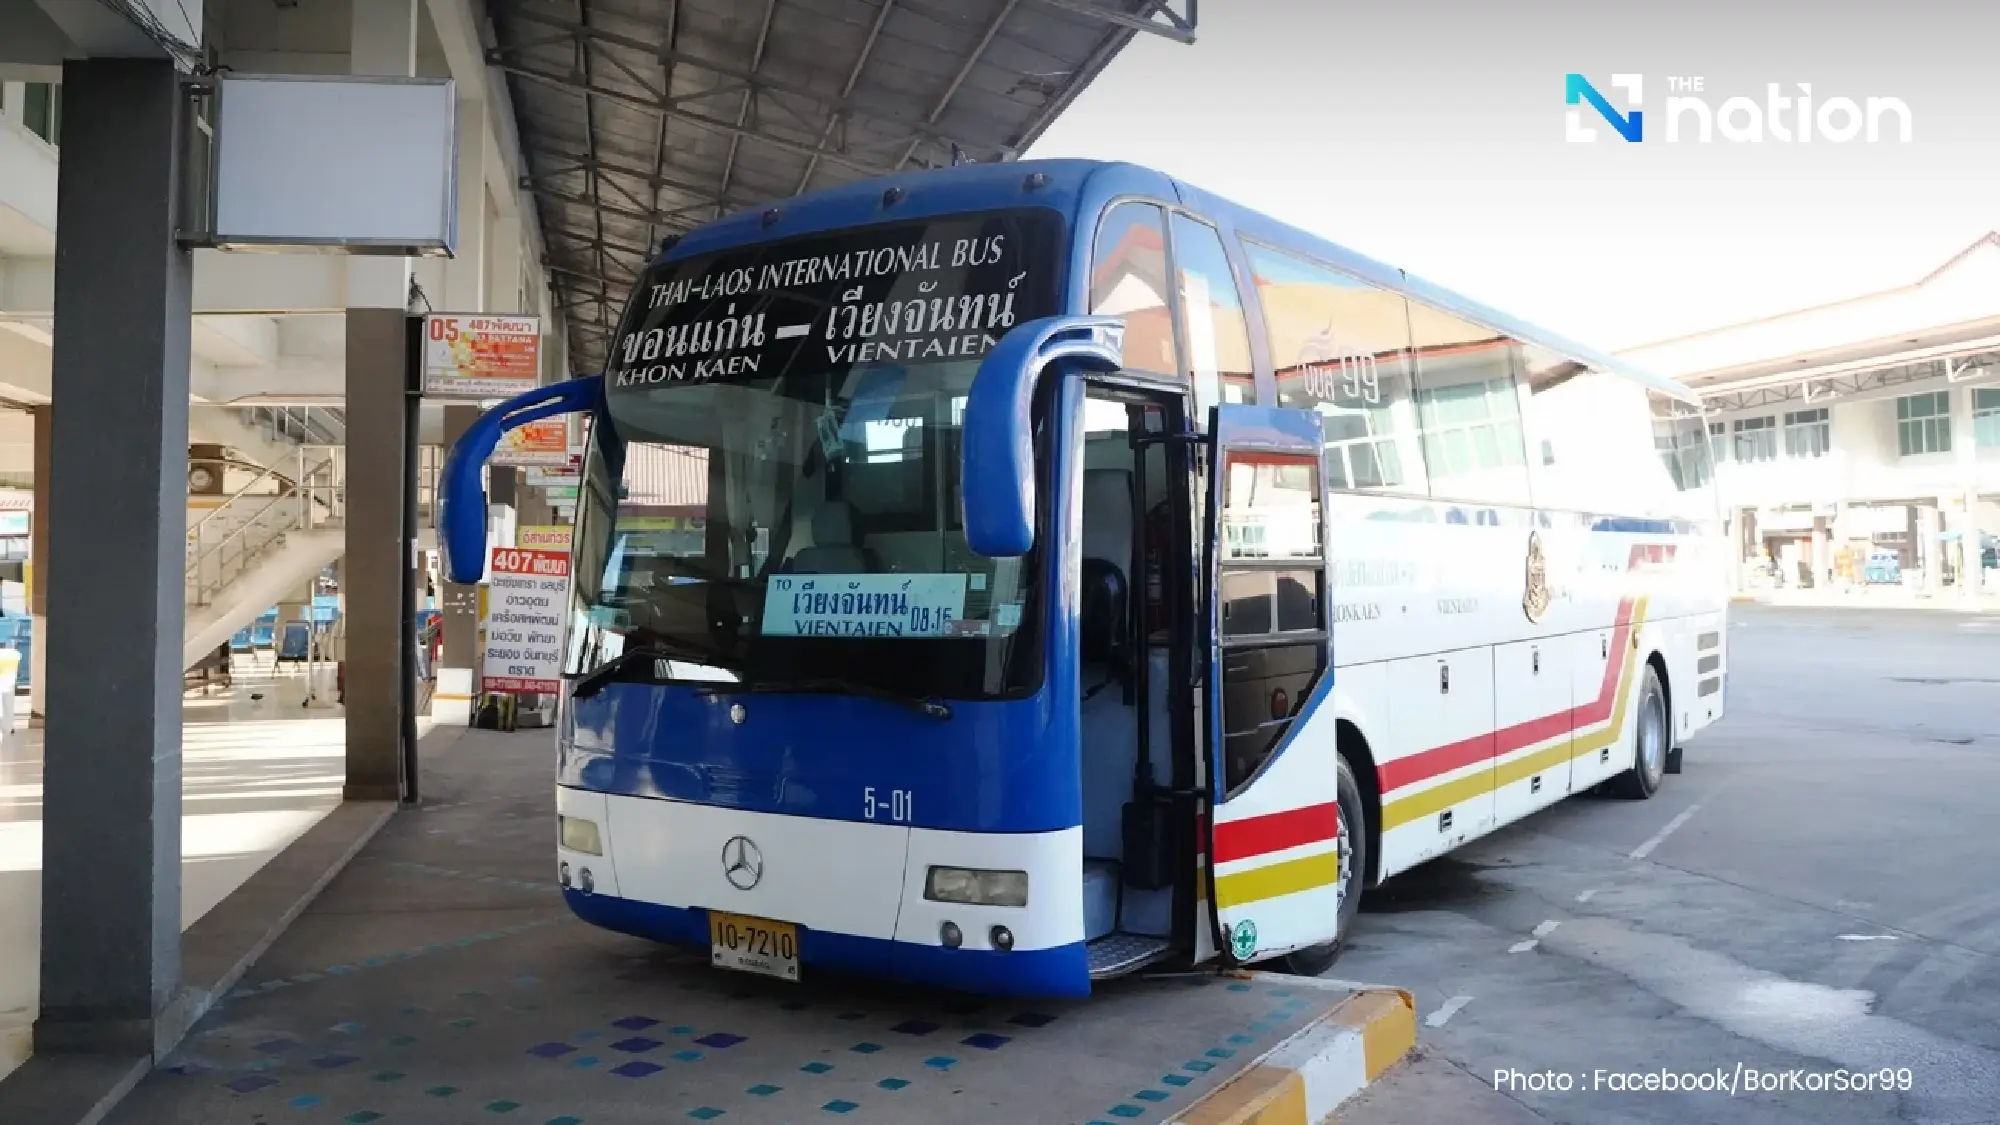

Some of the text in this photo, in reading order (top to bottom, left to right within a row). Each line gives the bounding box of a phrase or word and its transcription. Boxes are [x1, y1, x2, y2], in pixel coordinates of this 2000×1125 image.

[649, 235, 1004, 308] THAI-LAOS INTERNATIONAL BUS
[430, 318, 459, 341] 05
[623, 303, 765, 363] ขอนแก่น
[826, 271, 1026, 340] เวียงจันทน์
[616, 354, 761, 387] KHON KAEN
[1341, 348, 1379, 404] 99
[494, 550, 532, 572] 407
[776, 579, 791, 591] TO
[793, 579, 912, 615] เวียงจันทน์
[795, 619, 903, 637] VIENTAIEN
[864, 786, 912, 822] 5-01
[717, 921, 793, 960] 10-7210
